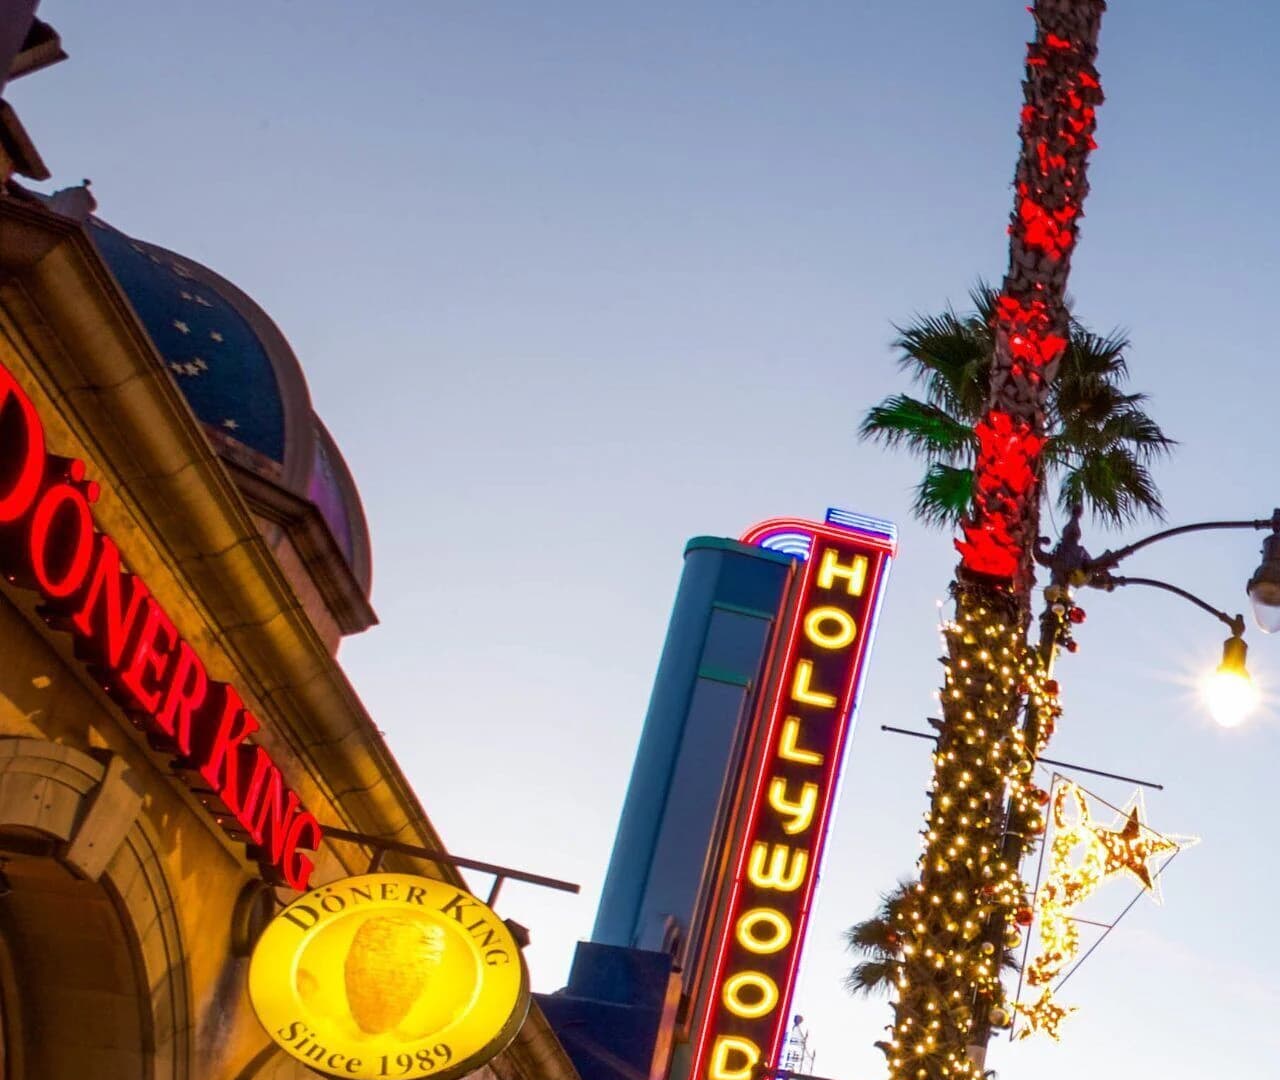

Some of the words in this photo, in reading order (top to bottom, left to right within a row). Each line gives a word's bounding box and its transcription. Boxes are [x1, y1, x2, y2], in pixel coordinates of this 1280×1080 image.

[0, 362, 208, 756] DÖNER
[201, 683, 323, 892] KING
[281, 883, 428, 931] DÖNER
[439, 893, 510, 967] KING
[277, 1020, 363, 1074] Since
[376, 1042, 453, 1077] 1989
